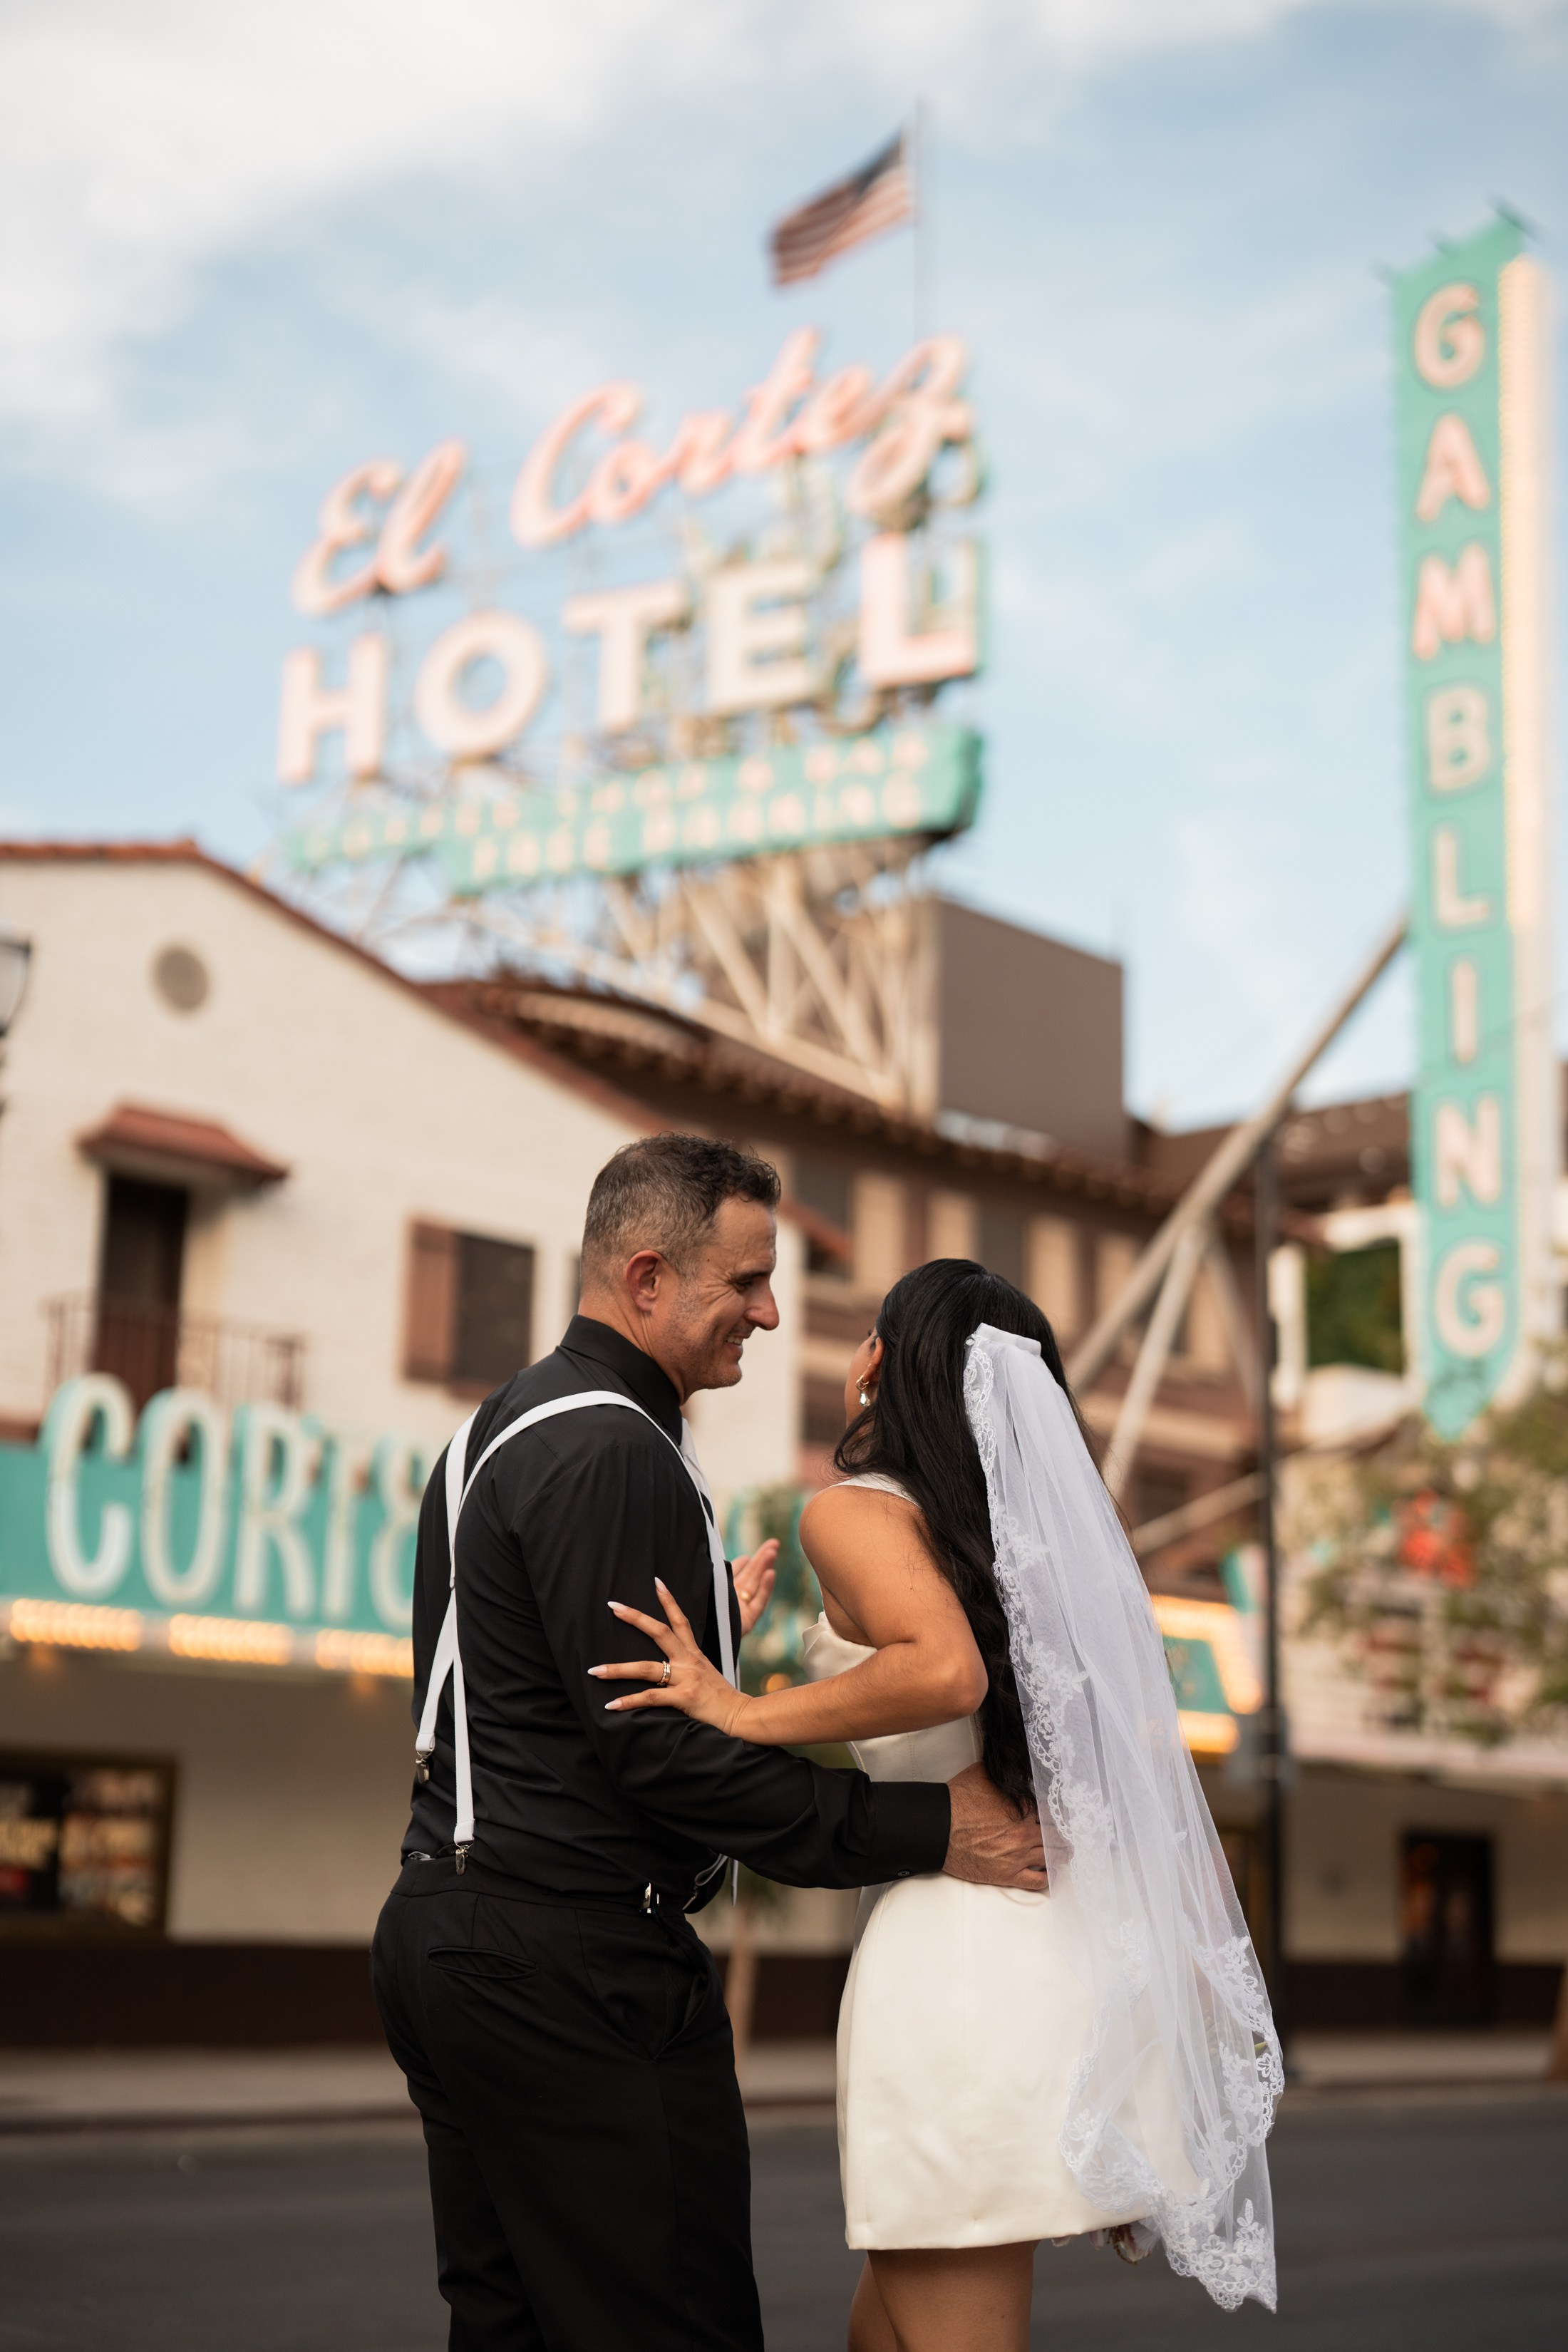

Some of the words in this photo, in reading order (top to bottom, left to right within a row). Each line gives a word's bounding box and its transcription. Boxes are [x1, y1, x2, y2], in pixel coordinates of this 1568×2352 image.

[293, 438, 466, 617] El
[509, 324, 974, 550] Cortez
[277, 530, 978, 784] HOTEL
[1413, 280, 1507, 1359] GAMBLING
